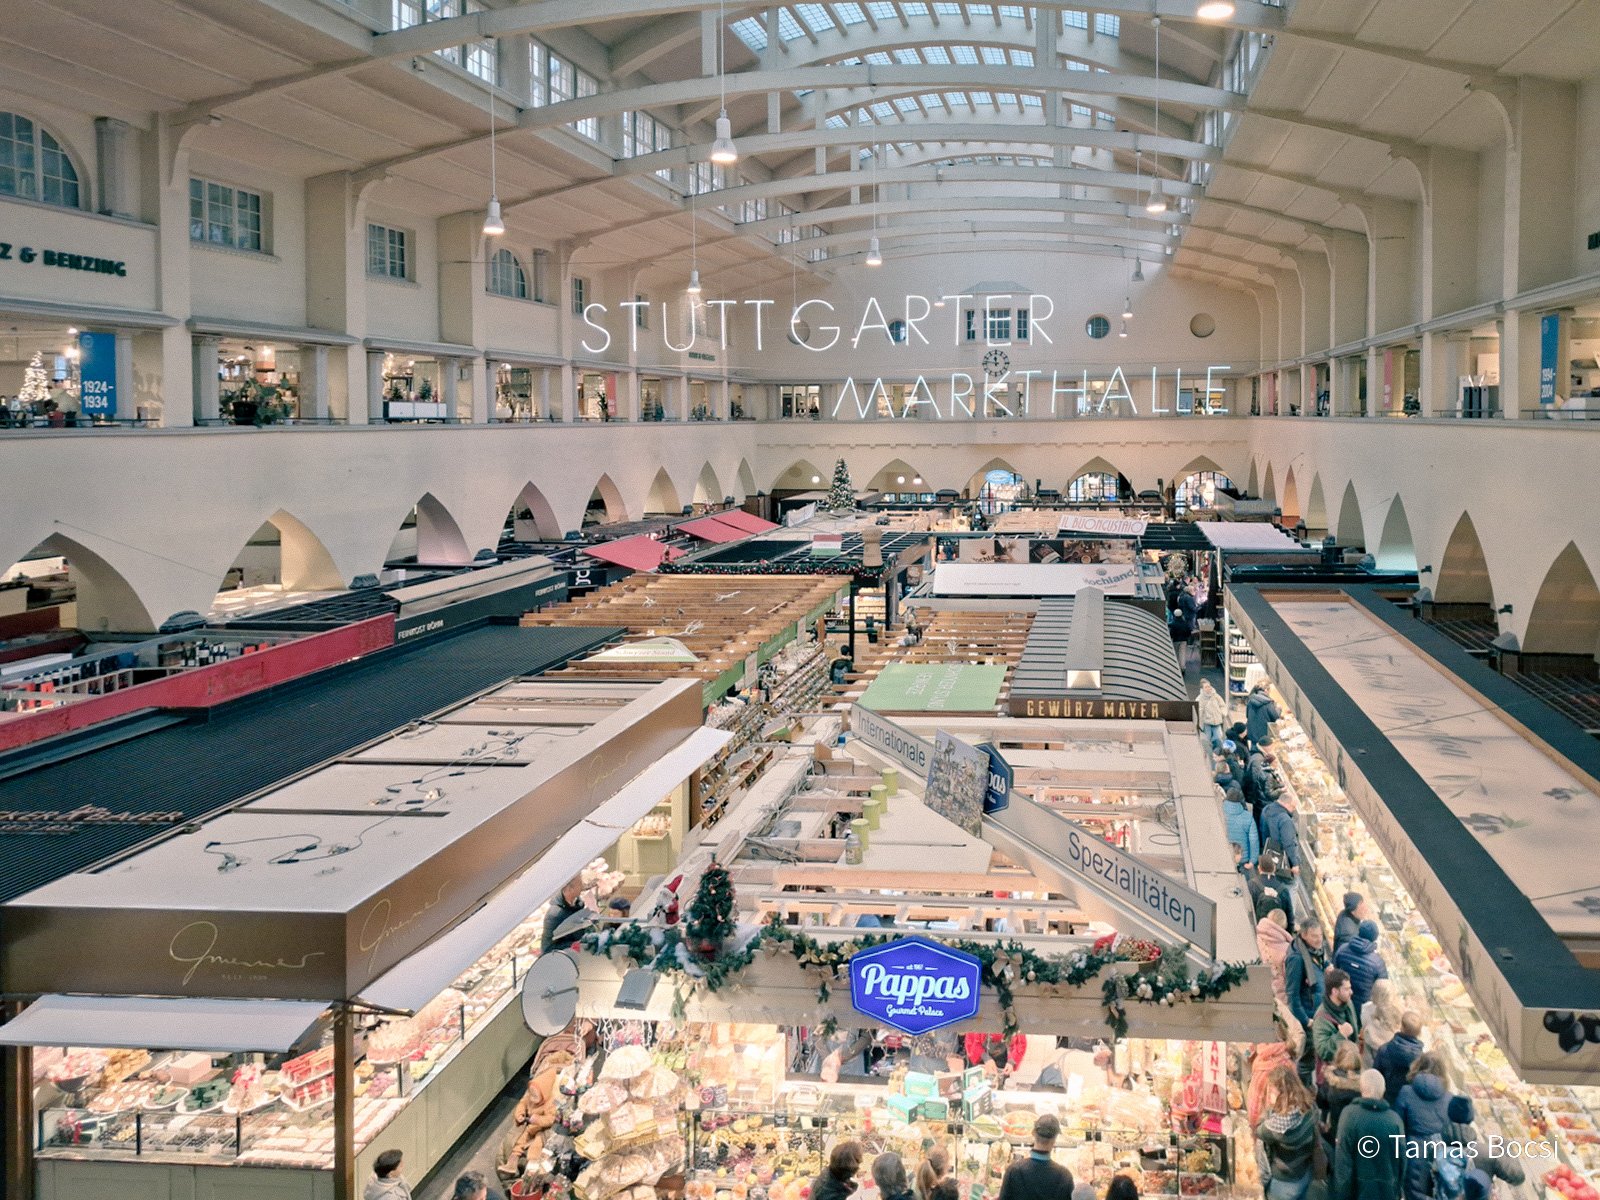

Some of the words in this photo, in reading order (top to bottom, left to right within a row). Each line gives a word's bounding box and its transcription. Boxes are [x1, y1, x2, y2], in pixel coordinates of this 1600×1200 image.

[20, 246, 37, 263] &
[43, 249, 127, 277] BENZING
[582, 295, 1054, 352] STUTTGARTER
[82, 381, 114, 393] 1924-
[83, 395, 108, 409] 1934
[832, 366, 1232, 419] MARKTHALLE
[1026, 698, 1094, 718] GEWÜRZ
[1104, 701, 1160, 718] MAYER
[857, 711, 926, 768] Internationale
[1068, 831, 1196, 932] Spezialitäten
[861, 963, 971, 1006] Pappas
[886, 1004, 918, 1018] Gourmet
